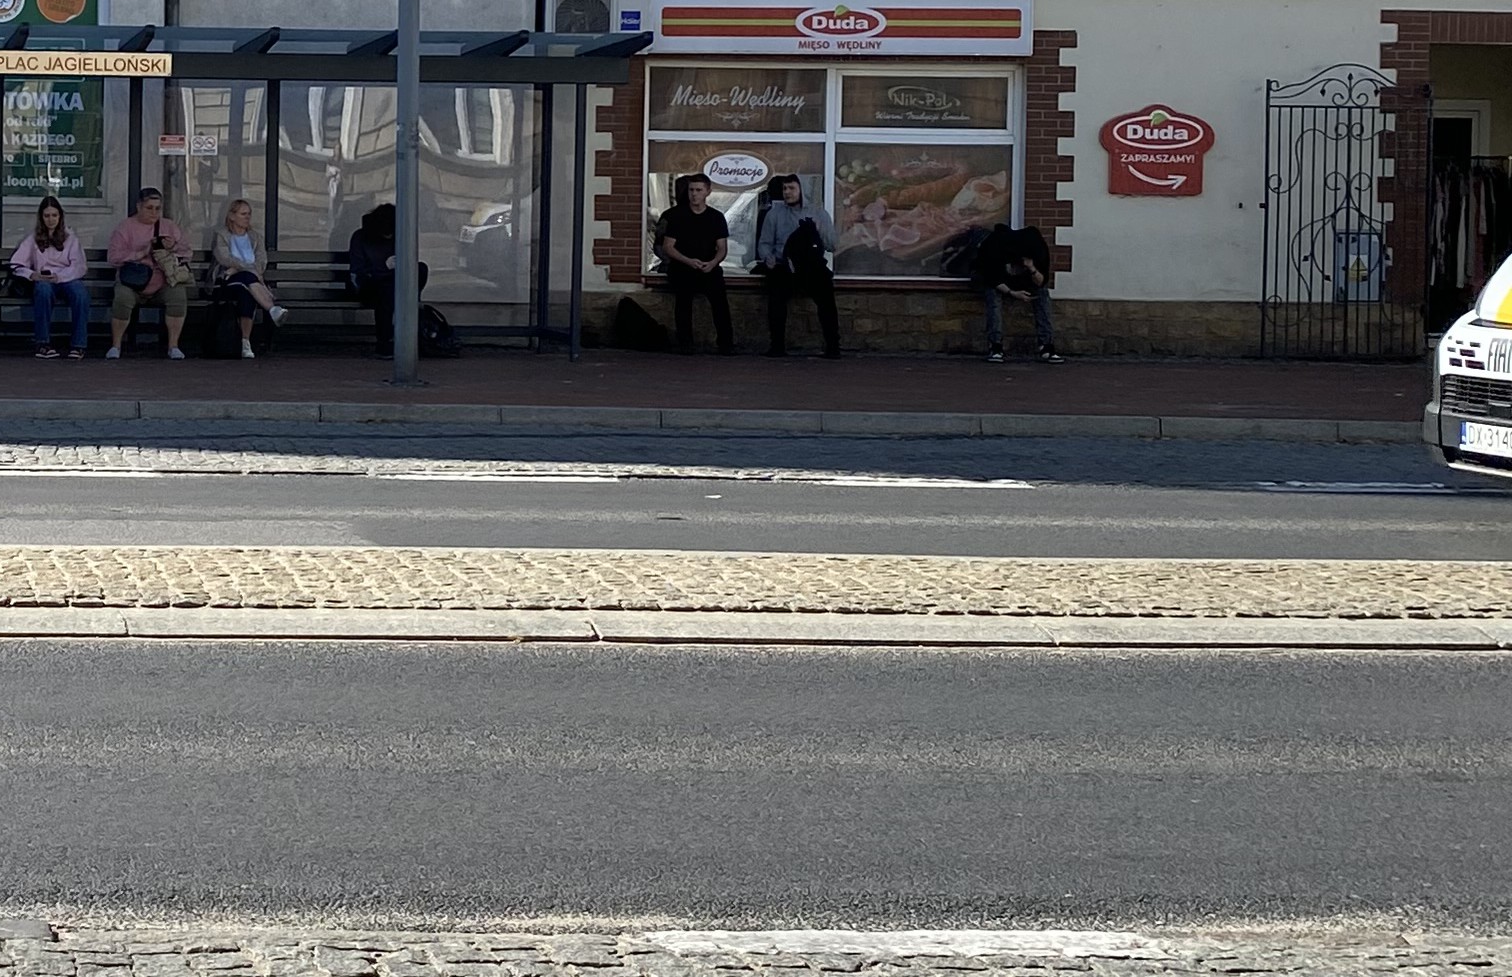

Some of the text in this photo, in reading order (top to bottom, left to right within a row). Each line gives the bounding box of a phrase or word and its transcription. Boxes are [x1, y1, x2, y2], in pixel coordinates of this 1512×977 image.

[811, 15, 869, 30] Duda
[798, 40, 882, 51] MIĘSO WĘDLINY
[44, 55, 167, 73] JAGIELLOŃSKI
[1126, 124, 1189, 141] Duda
[709, 160, 764, 182] Promocje
